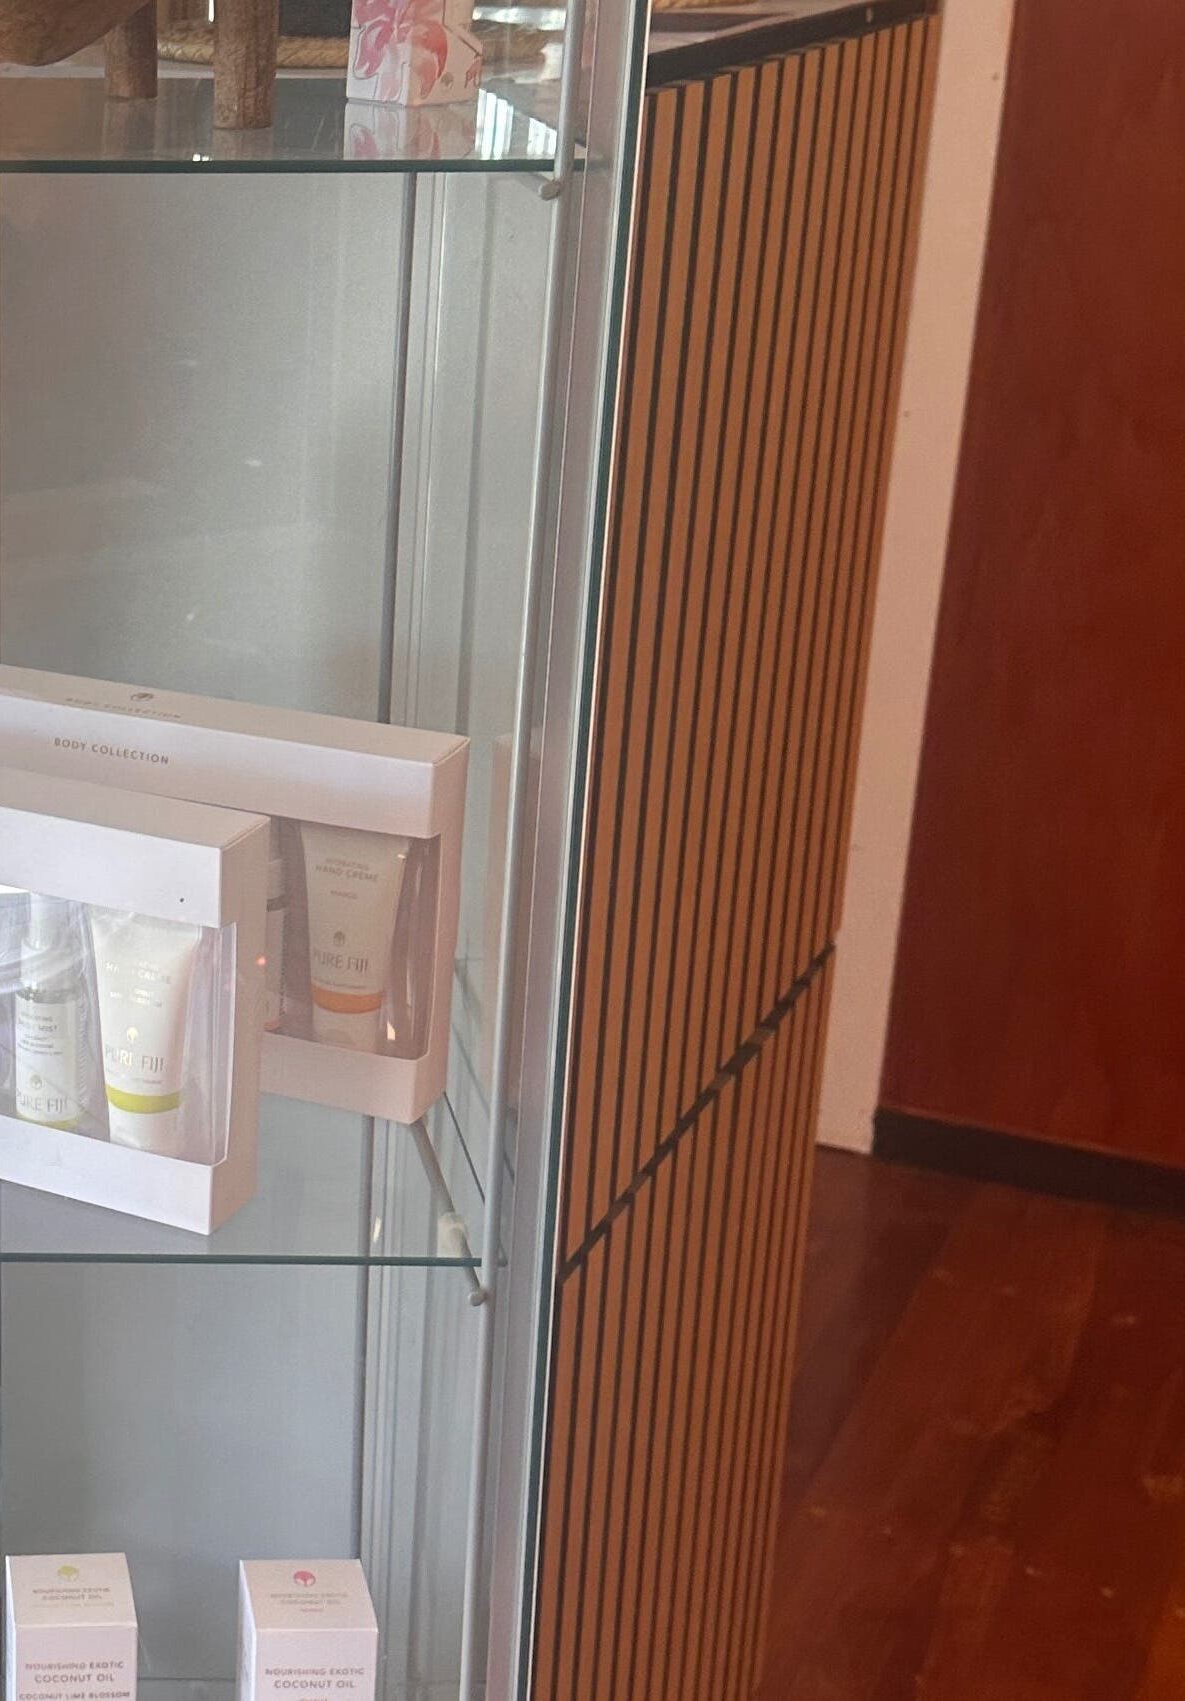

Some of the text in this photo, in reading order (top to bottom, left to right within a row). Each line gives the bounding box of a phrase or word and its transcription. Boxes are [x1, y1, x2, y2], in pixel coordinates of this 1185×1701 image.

[54, 737, 170, 765] BODY COLLECTION
[347, 956, 369, 973] FIJI
[141, 1055, 165, 1073] FIJI
[25, 1661, 125, 1671] NOURISHING EXOTIC
[265, 1667, 367, 1676] NOURISHING EXOTIC
[34, 1672, 116, 1684] COCONUT OIL
[273, 1679, 356, 1689] COCONUT OIL
[19, 1690, 131, 1700] COCONUT LIME BLOSSOM
